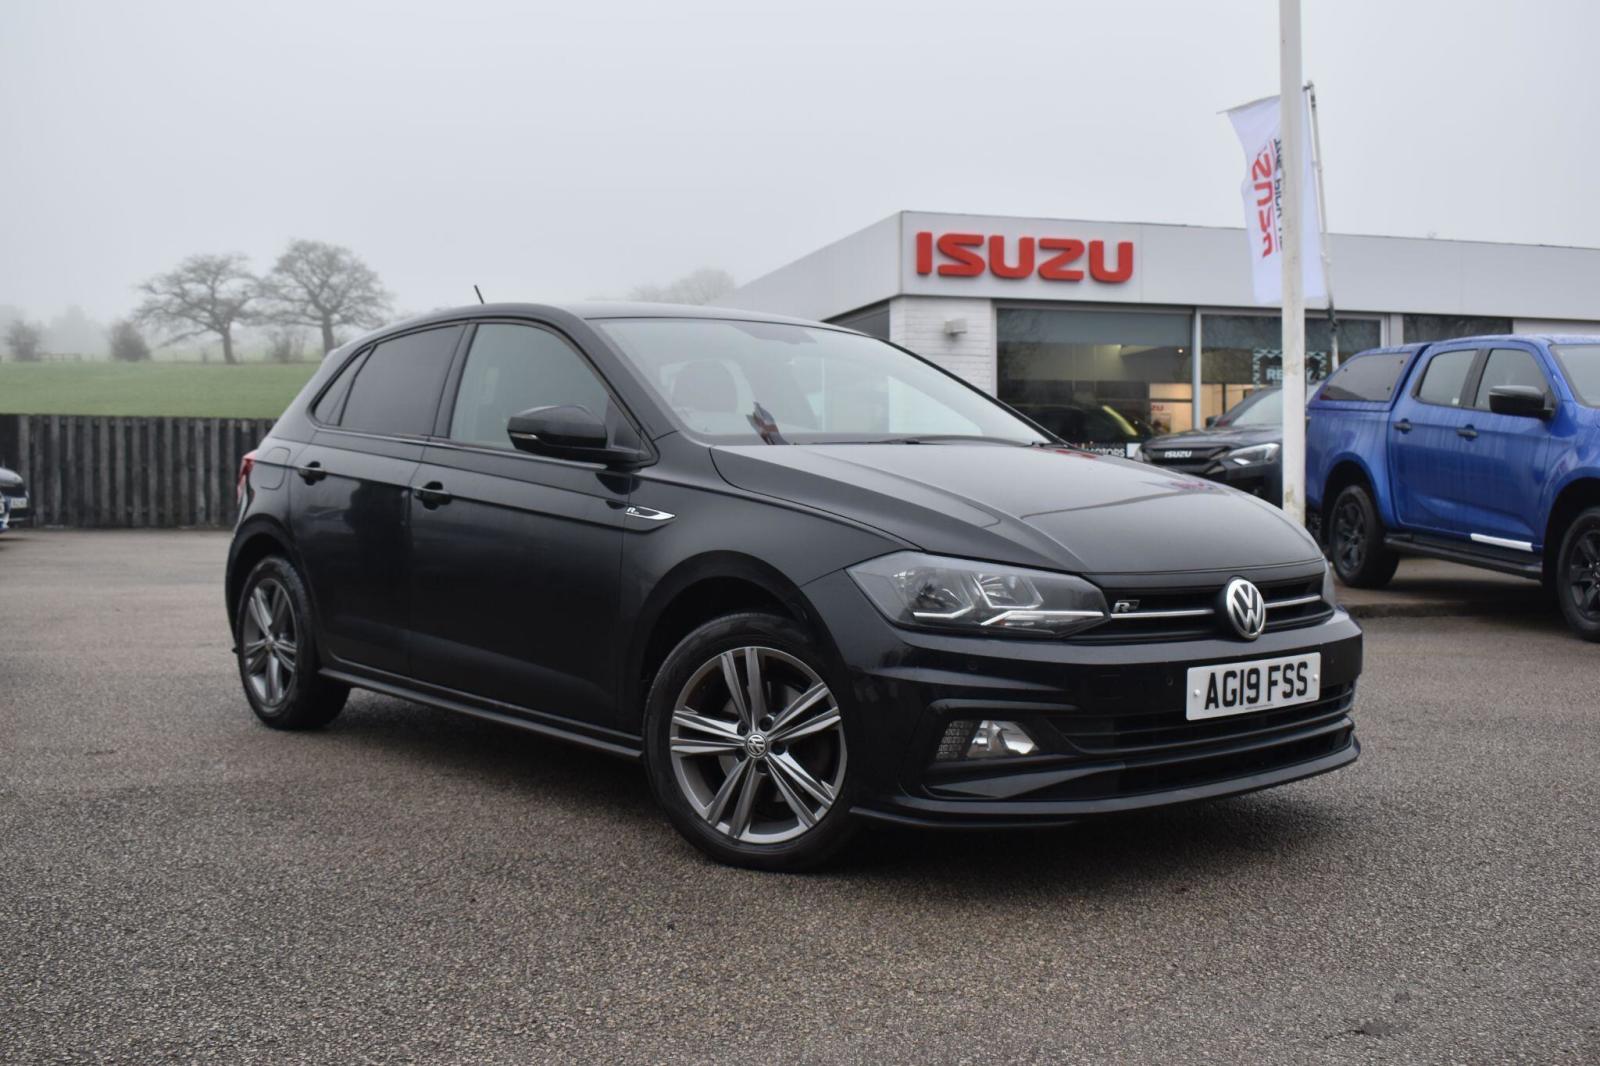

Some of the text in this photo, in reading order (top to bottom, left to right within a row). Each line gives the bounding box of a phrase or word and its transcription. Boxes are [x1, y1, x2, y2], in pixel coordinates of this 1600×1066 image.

[916, 231, 1134, 283] ISUZU
[1164, 450, 1192, 459] ISUZU
[1204, 661, 1308, 710] AG19 FSS
